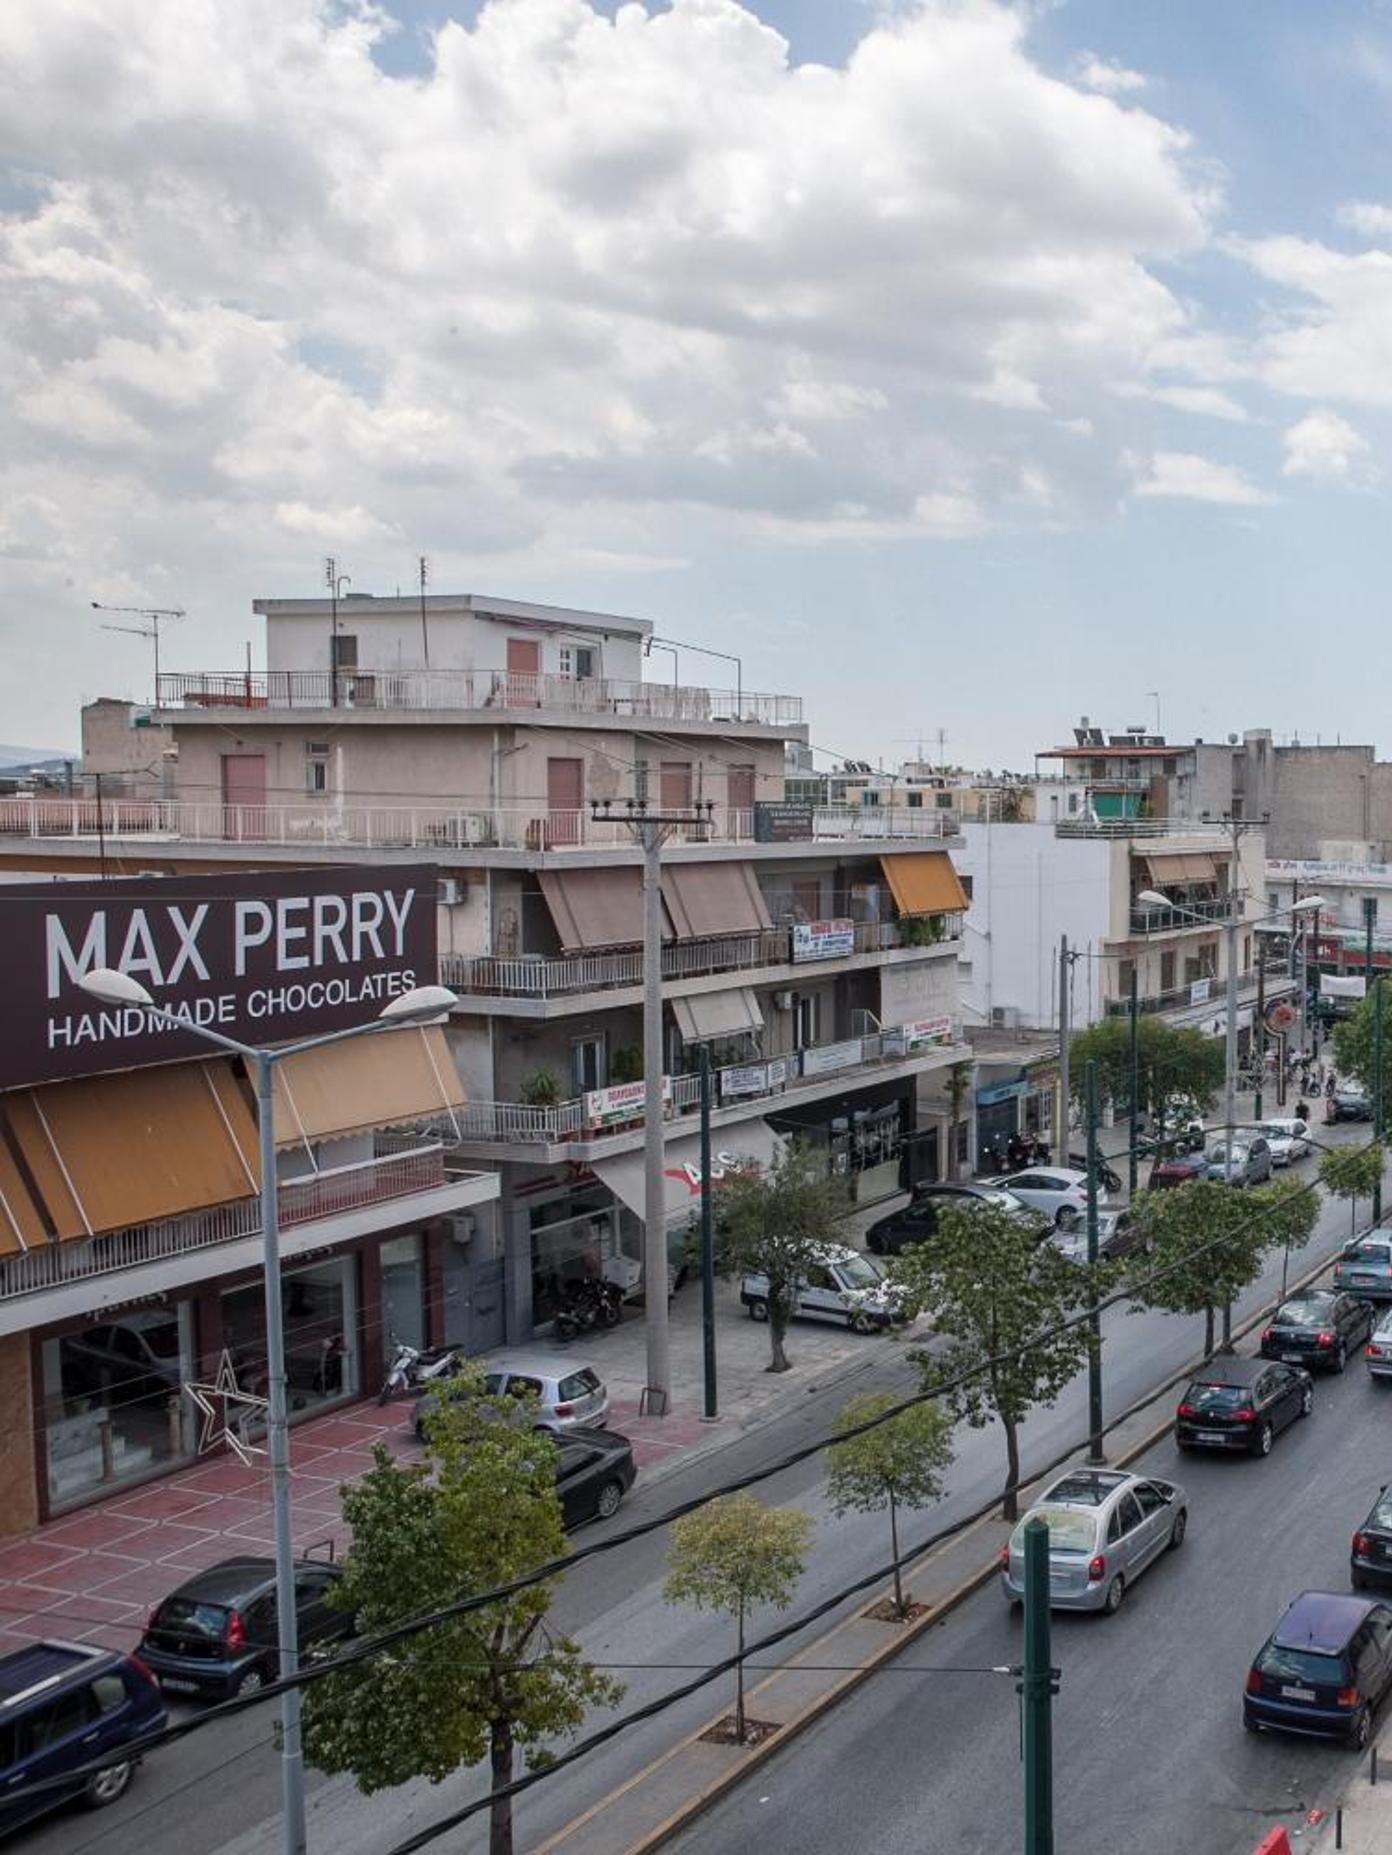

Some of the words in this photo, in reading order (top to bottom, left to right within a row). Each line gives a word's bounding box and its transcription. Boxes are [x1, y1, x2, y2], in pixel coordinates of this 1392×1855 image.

[46, 903, 211, 999] MAX
[234, 888, 416, 977] PERRY
[47, 994, 236, 1049] HANDMADE
[246, 969, 417, 1018] CHOCOLATES
